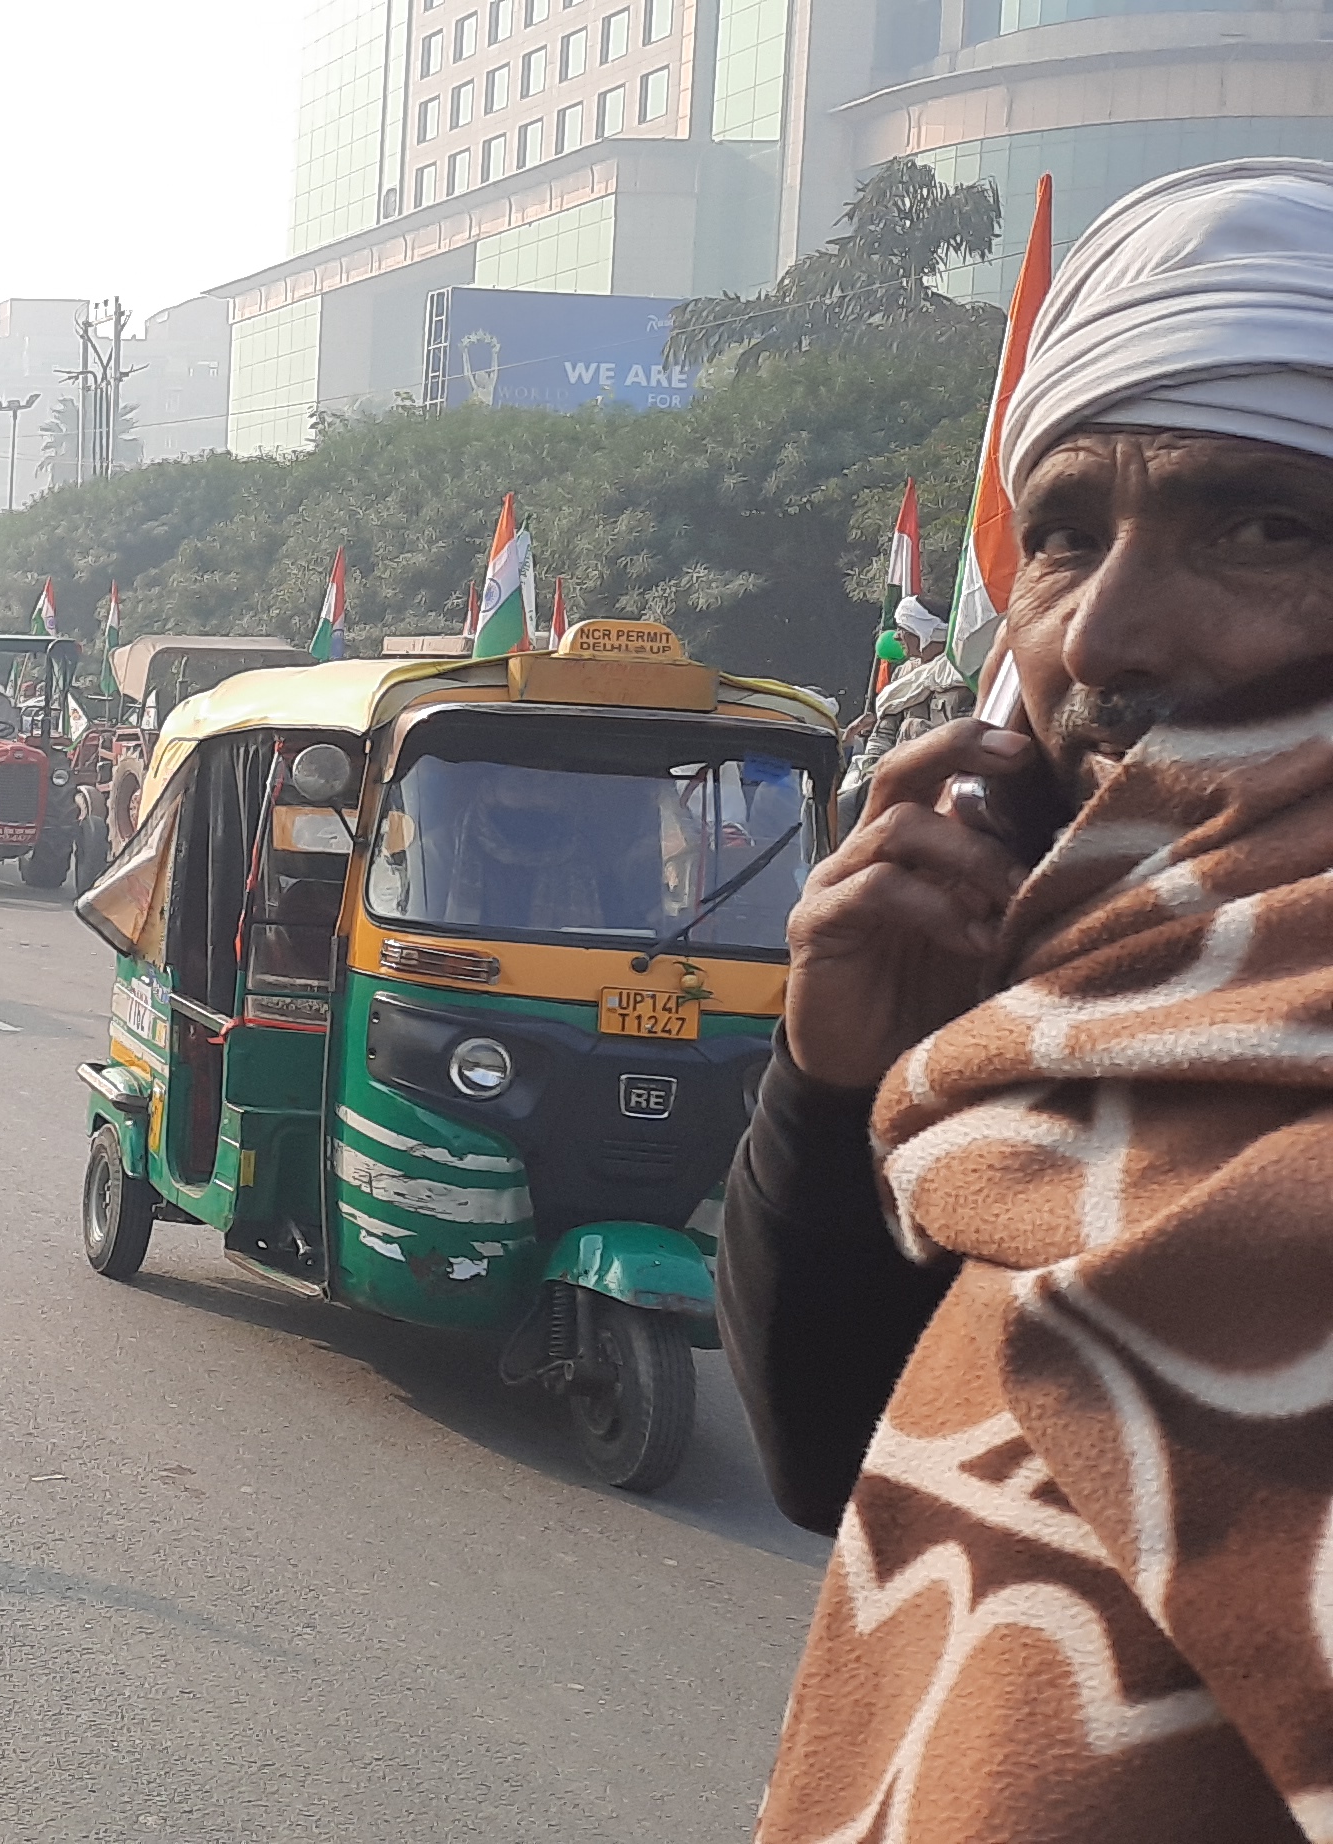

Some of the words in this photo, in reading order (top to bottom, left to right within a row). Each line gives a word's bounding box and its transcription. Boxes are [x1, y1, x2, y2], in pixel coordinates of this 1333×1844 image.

[564, 362, 616, 386] WE
[623, 364, 688, 388] ARE
[648, 393, 682, 408] FOR
[579, 628, 612, 642] NCR
[615, 629, 672, 645] PERMIT
[649, 645, 672, 655] UP
[617, 1012, 687, 1036] T1247
[629, 1088, 666, 1110] RE
